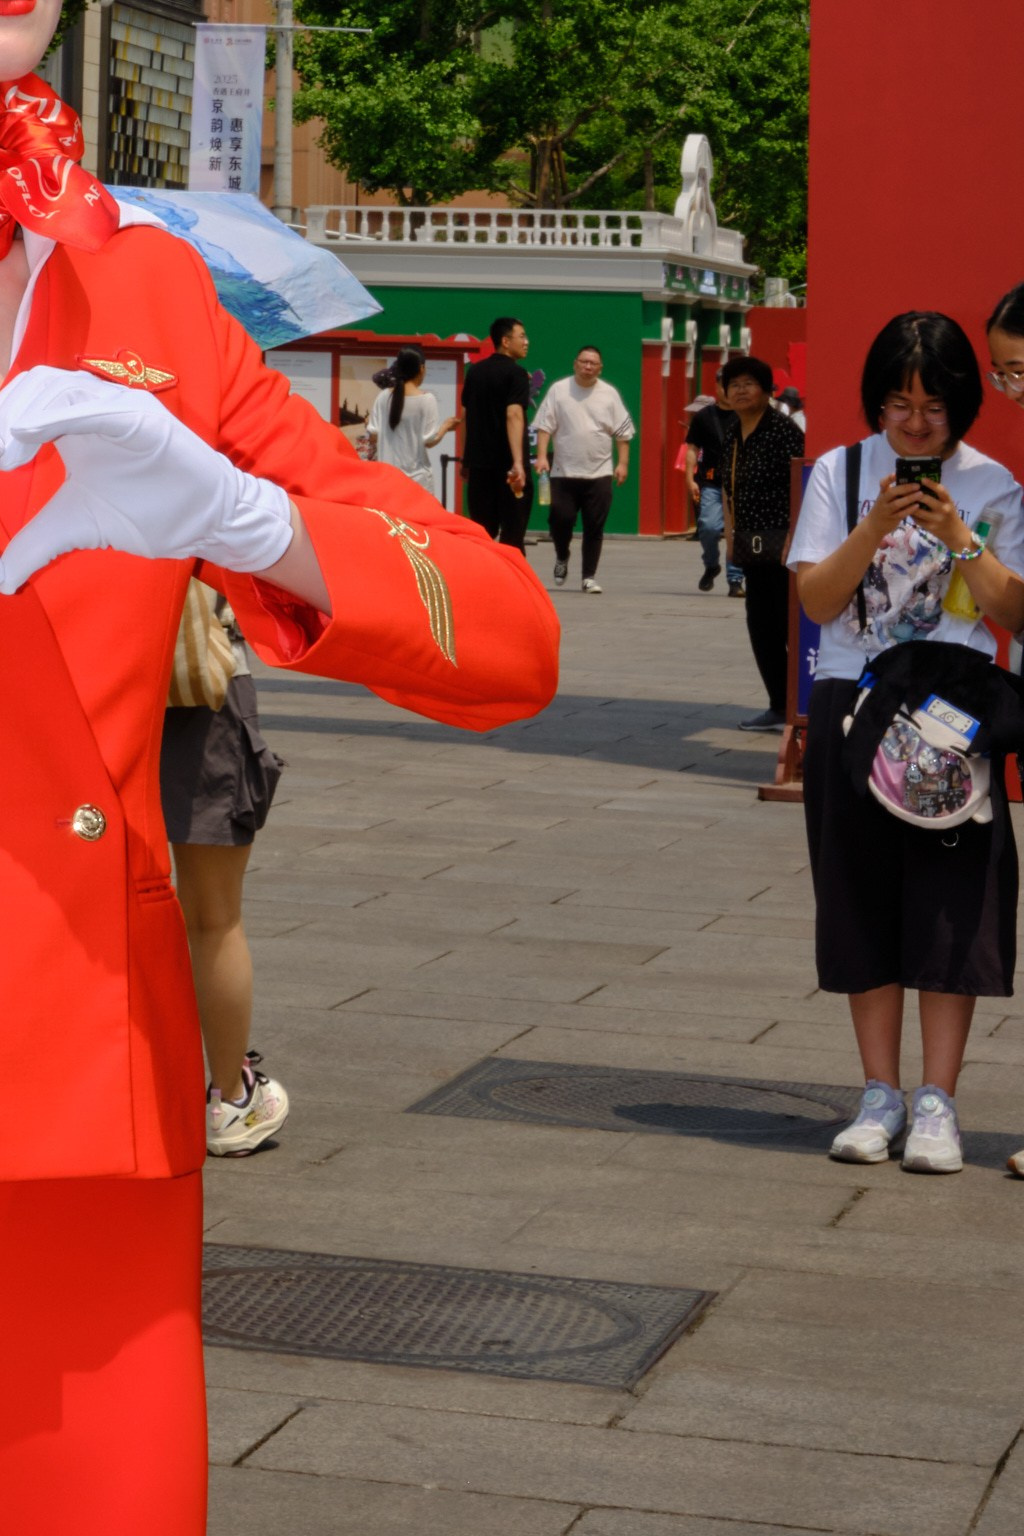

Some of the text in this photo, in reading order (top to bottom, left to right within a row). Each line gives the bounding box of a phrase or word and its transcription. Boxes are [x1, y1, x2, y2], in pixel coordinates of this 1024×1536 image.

[214, 74, 238, 84] 2025
[209, 99, 223, 171] 京韵焕新
[228, 118, 243, 190] 惠享东城
